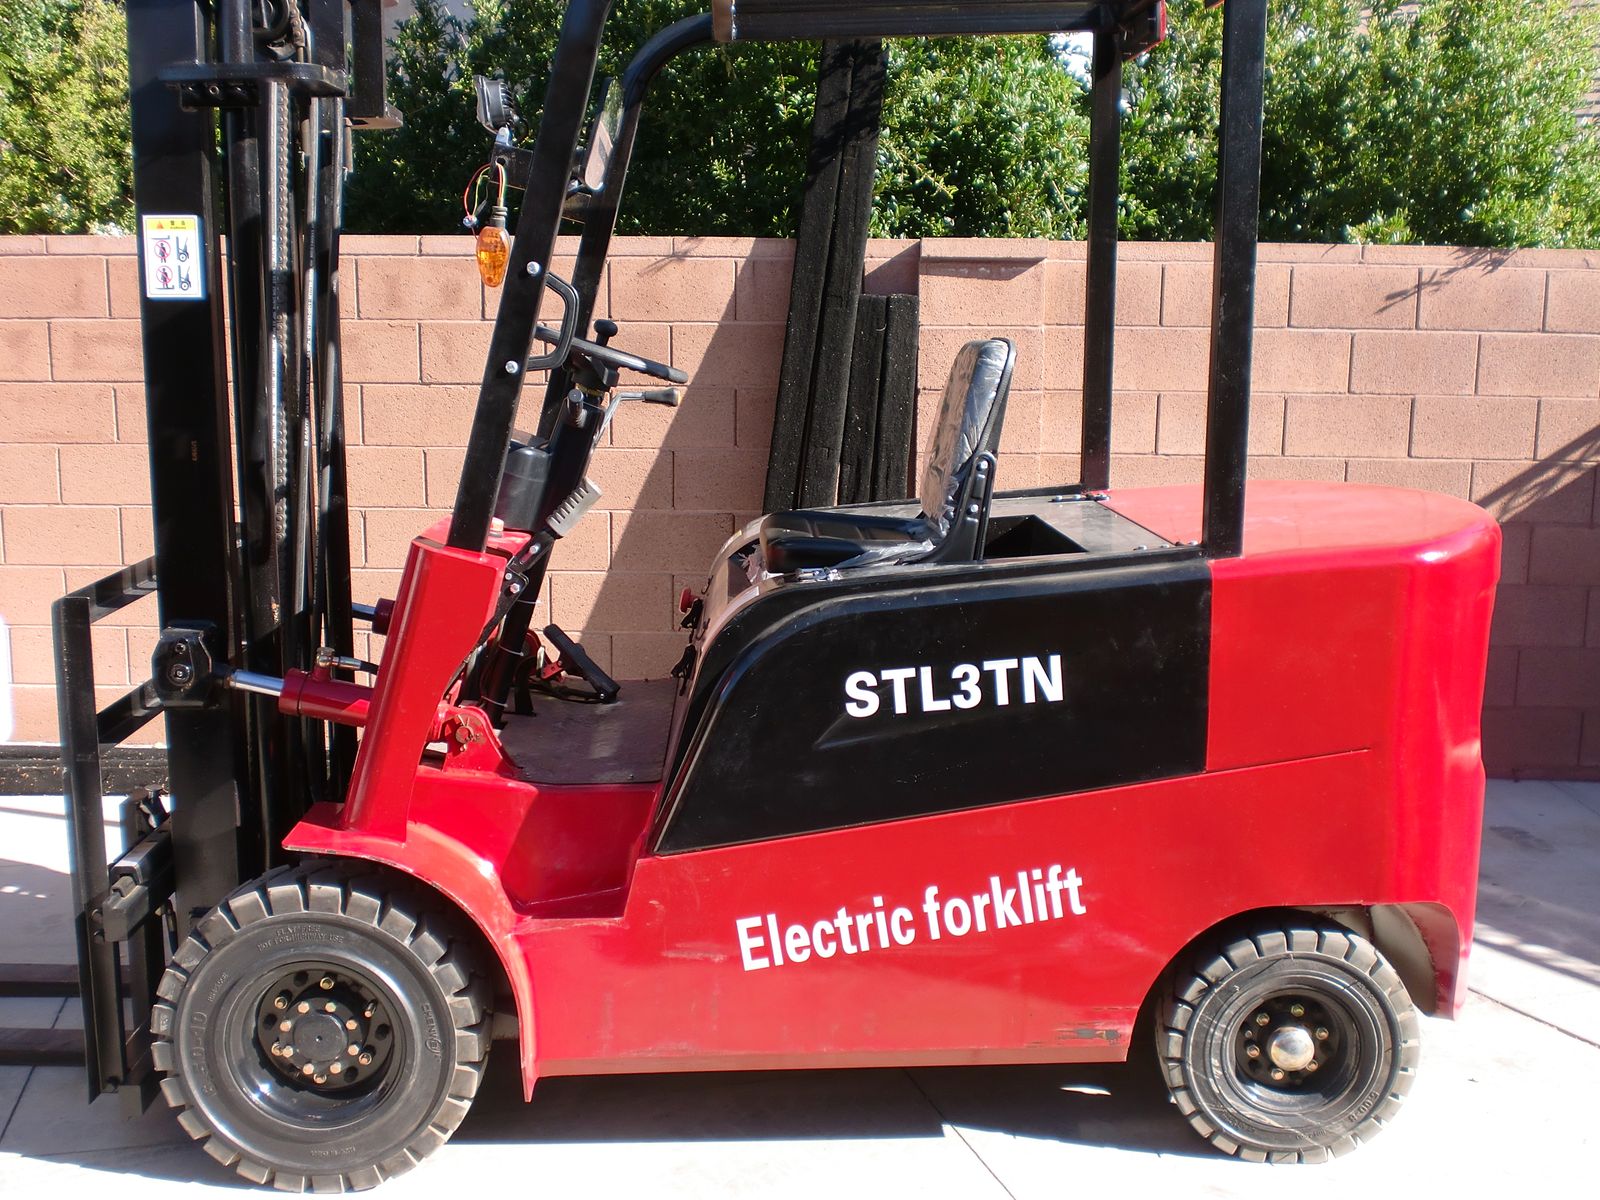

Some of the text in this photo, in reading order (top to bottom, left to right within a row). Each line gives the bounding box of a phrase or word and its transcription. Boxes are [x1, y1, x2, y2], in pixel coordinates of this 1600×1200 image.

[844, 653, 1065, 718] STL3TN
[735, 864, 1087, 972] Electric forklift
